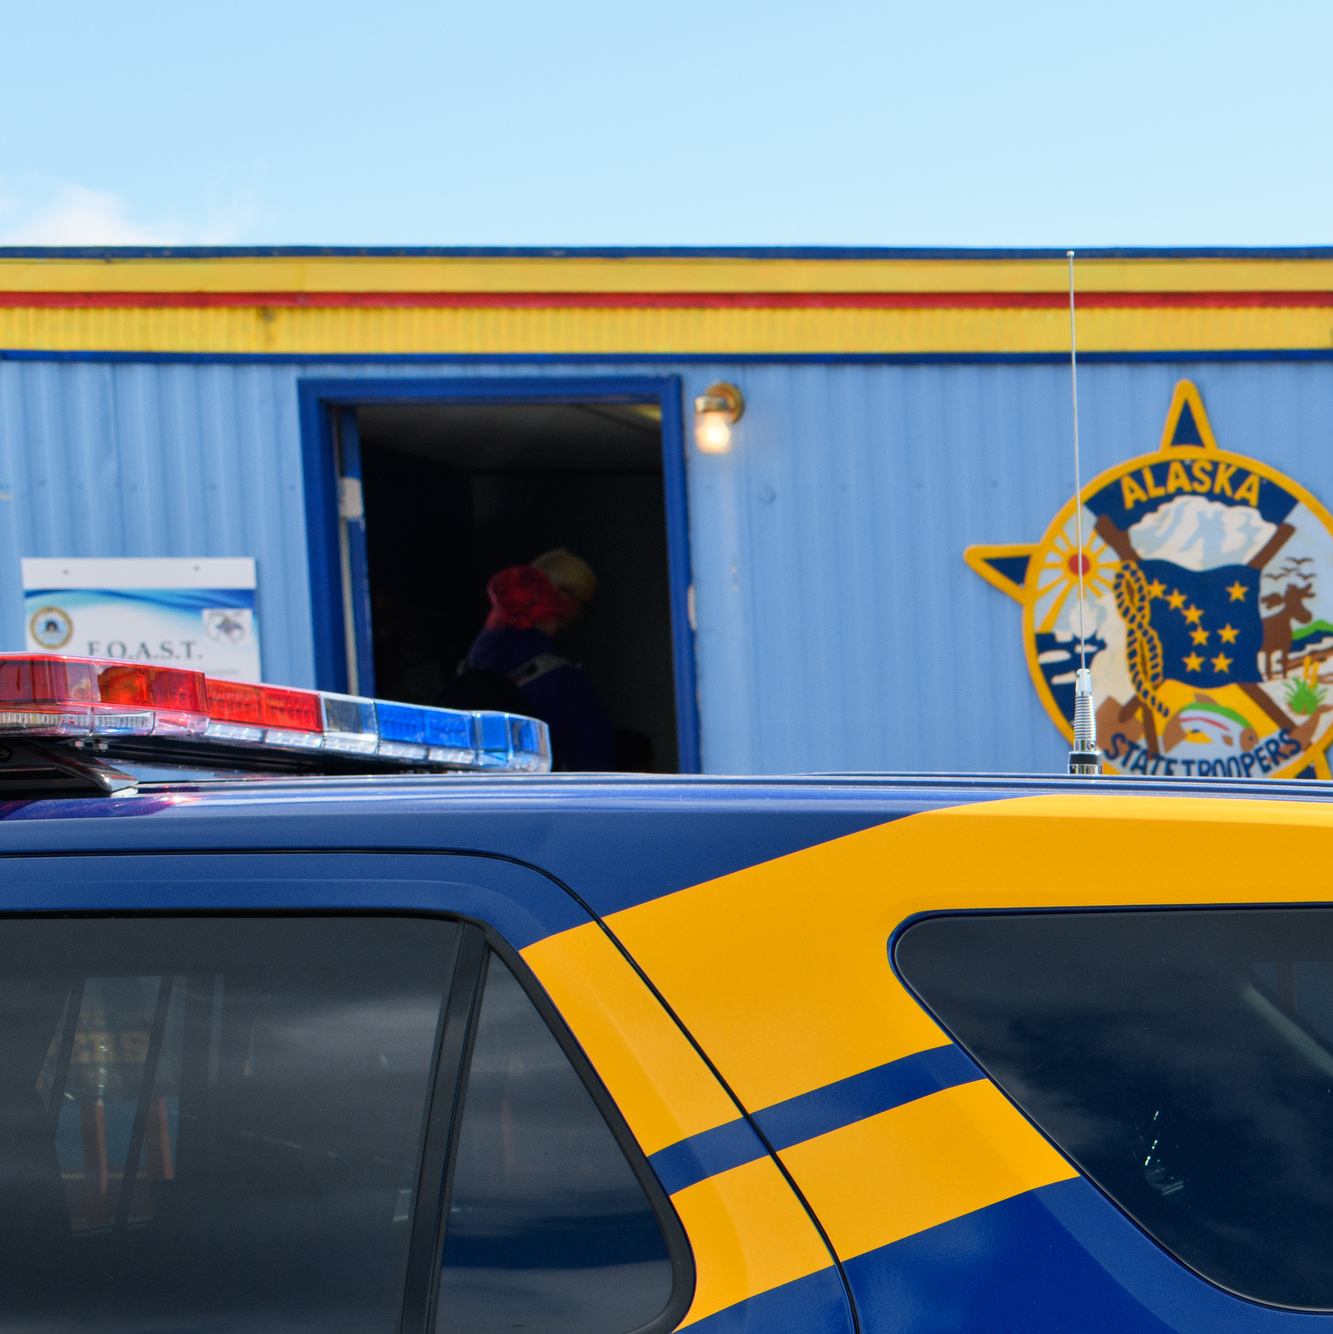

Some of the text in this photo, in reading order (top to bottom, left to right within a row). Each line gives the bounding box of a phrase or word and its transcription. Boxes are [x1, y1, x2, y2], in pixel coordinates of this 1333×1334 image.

[1119, 458, 1262, 510] ALASKA
[1104, 728, 1302, 778] STATE TROOPERS
